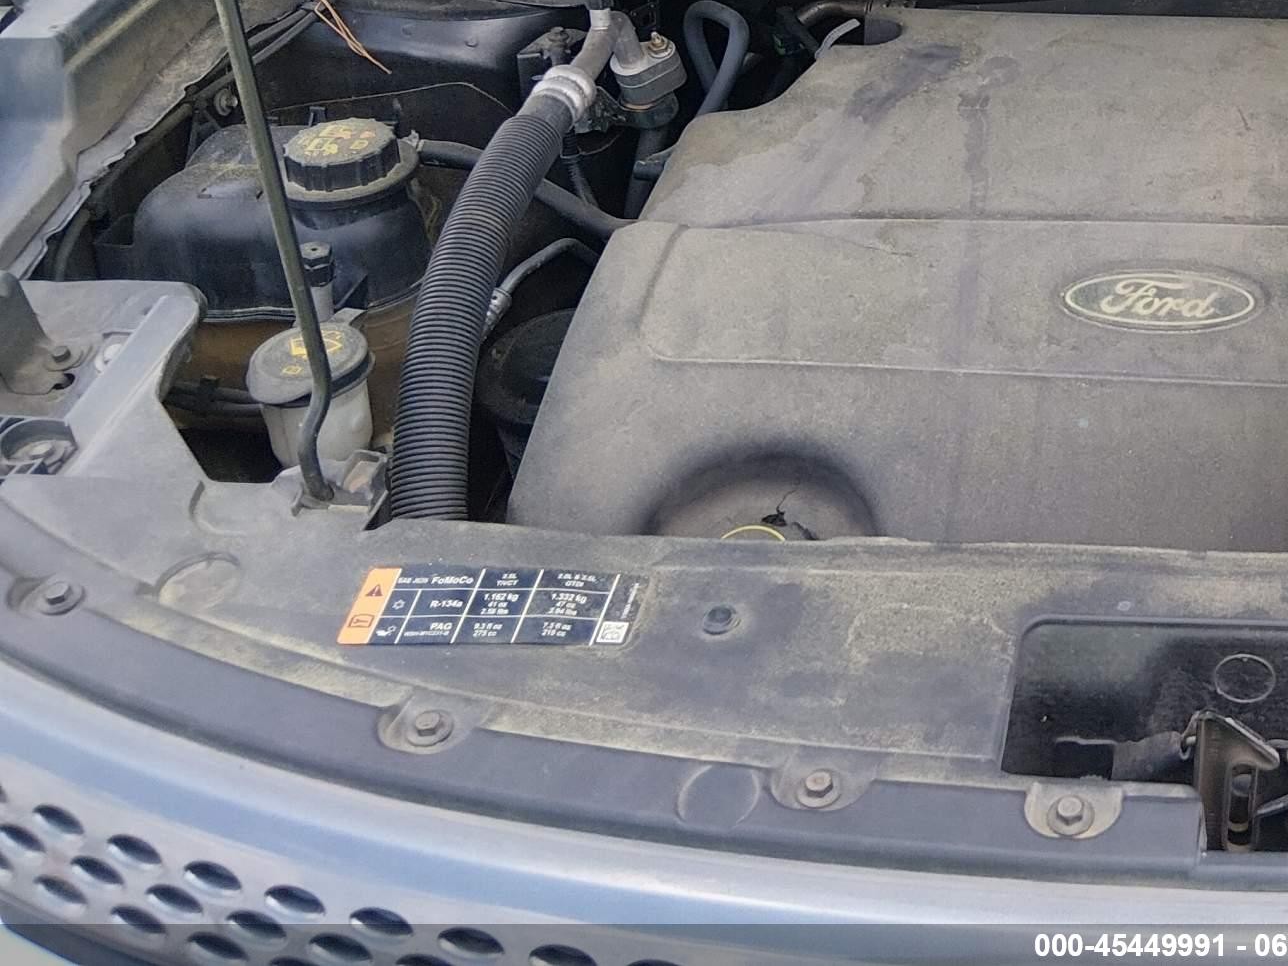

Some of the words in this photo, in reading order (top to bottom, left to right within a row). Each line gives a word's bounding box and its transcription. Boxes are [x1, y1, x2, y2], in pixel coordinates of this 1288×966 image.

[1101, 279, 1219, 317] Ford
[431, 576, 474, 584] FoMoCo
[507, 593, 520, 603] kg
[575, 594, 588, 605] kg
[430, 600, 463, 608] R-134a
[430, 622, 453, 630] PAG
